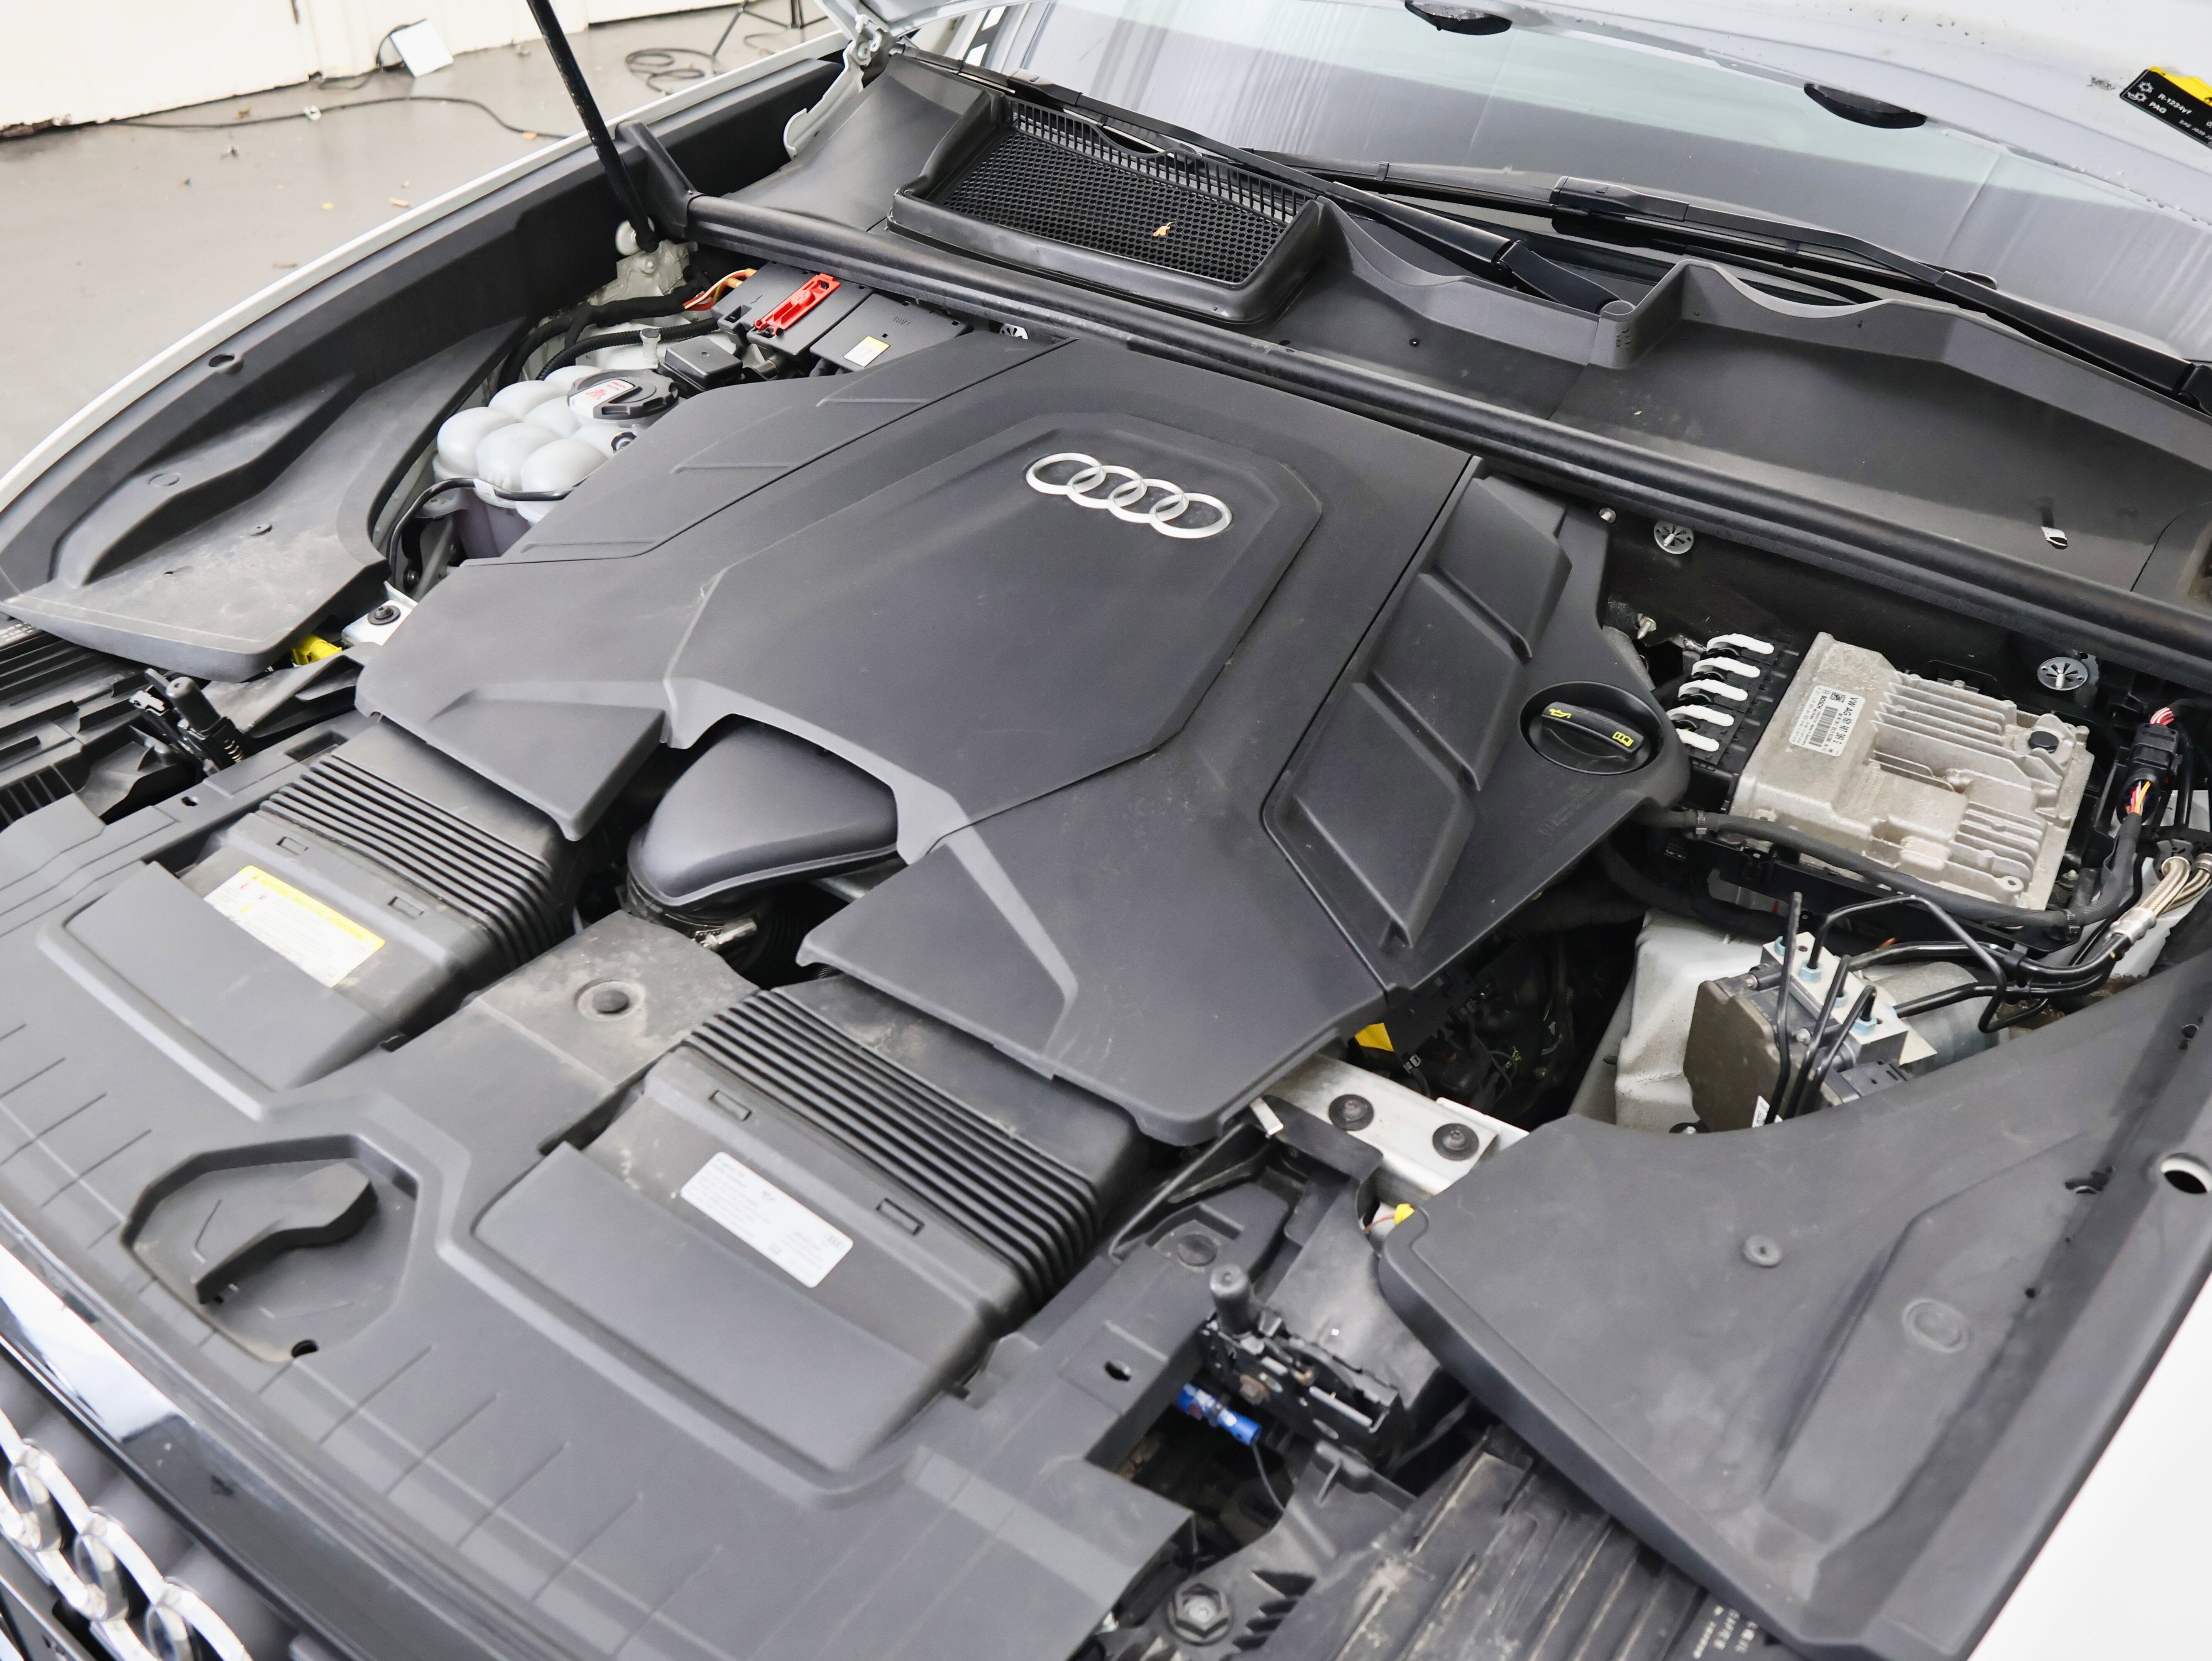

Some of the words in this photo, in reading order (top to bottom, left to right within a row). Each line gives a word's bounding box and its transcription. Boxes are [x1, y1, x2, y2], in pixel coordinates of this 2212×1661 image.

[2148, 101, 2167, 114] PAG
[1816, 695, 1828, 709] BOSCH
[1847, 697, 1859, 707] VW
[1843, 706, 1853, 716] AG
